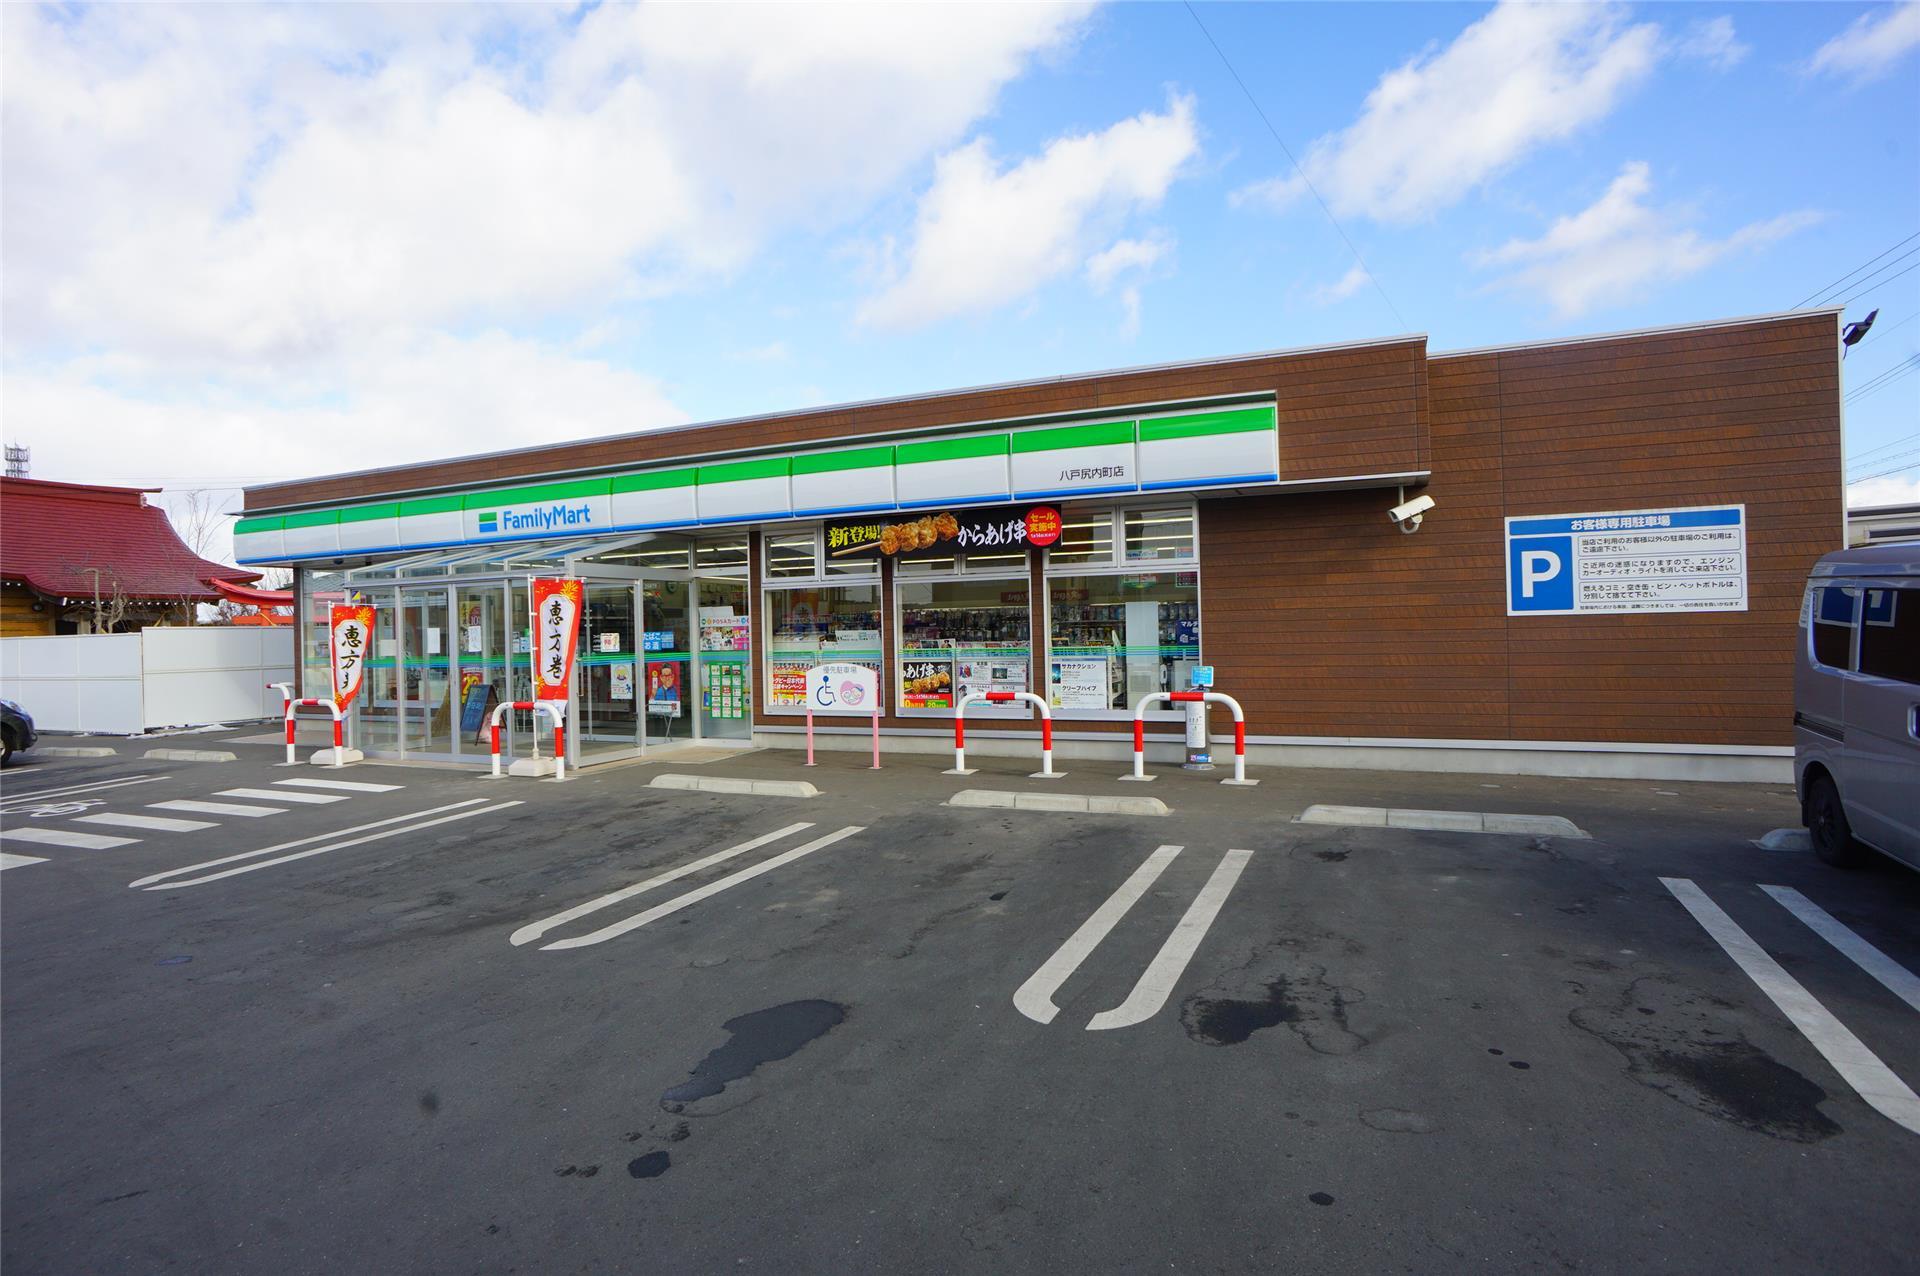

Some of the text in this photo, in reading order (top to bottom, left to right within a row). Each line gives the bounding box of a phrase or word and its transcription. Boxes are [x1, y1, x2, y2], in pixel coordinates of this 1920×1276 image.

[1059, 465, 1125, 481] 八戸尻内町店
[503, 504, 591, 530] FamilyMart
[1029, 522, 1057, 533] 実施中
[1030, 512, 1055, 522] セール
[1570, 515, 1671, 531] お客様専用駐車場
[957, 518, 1027, 547] からあげ串
[1521, 550, 1561, 598] P
[547, 601, 564, 679] 恵方巻
